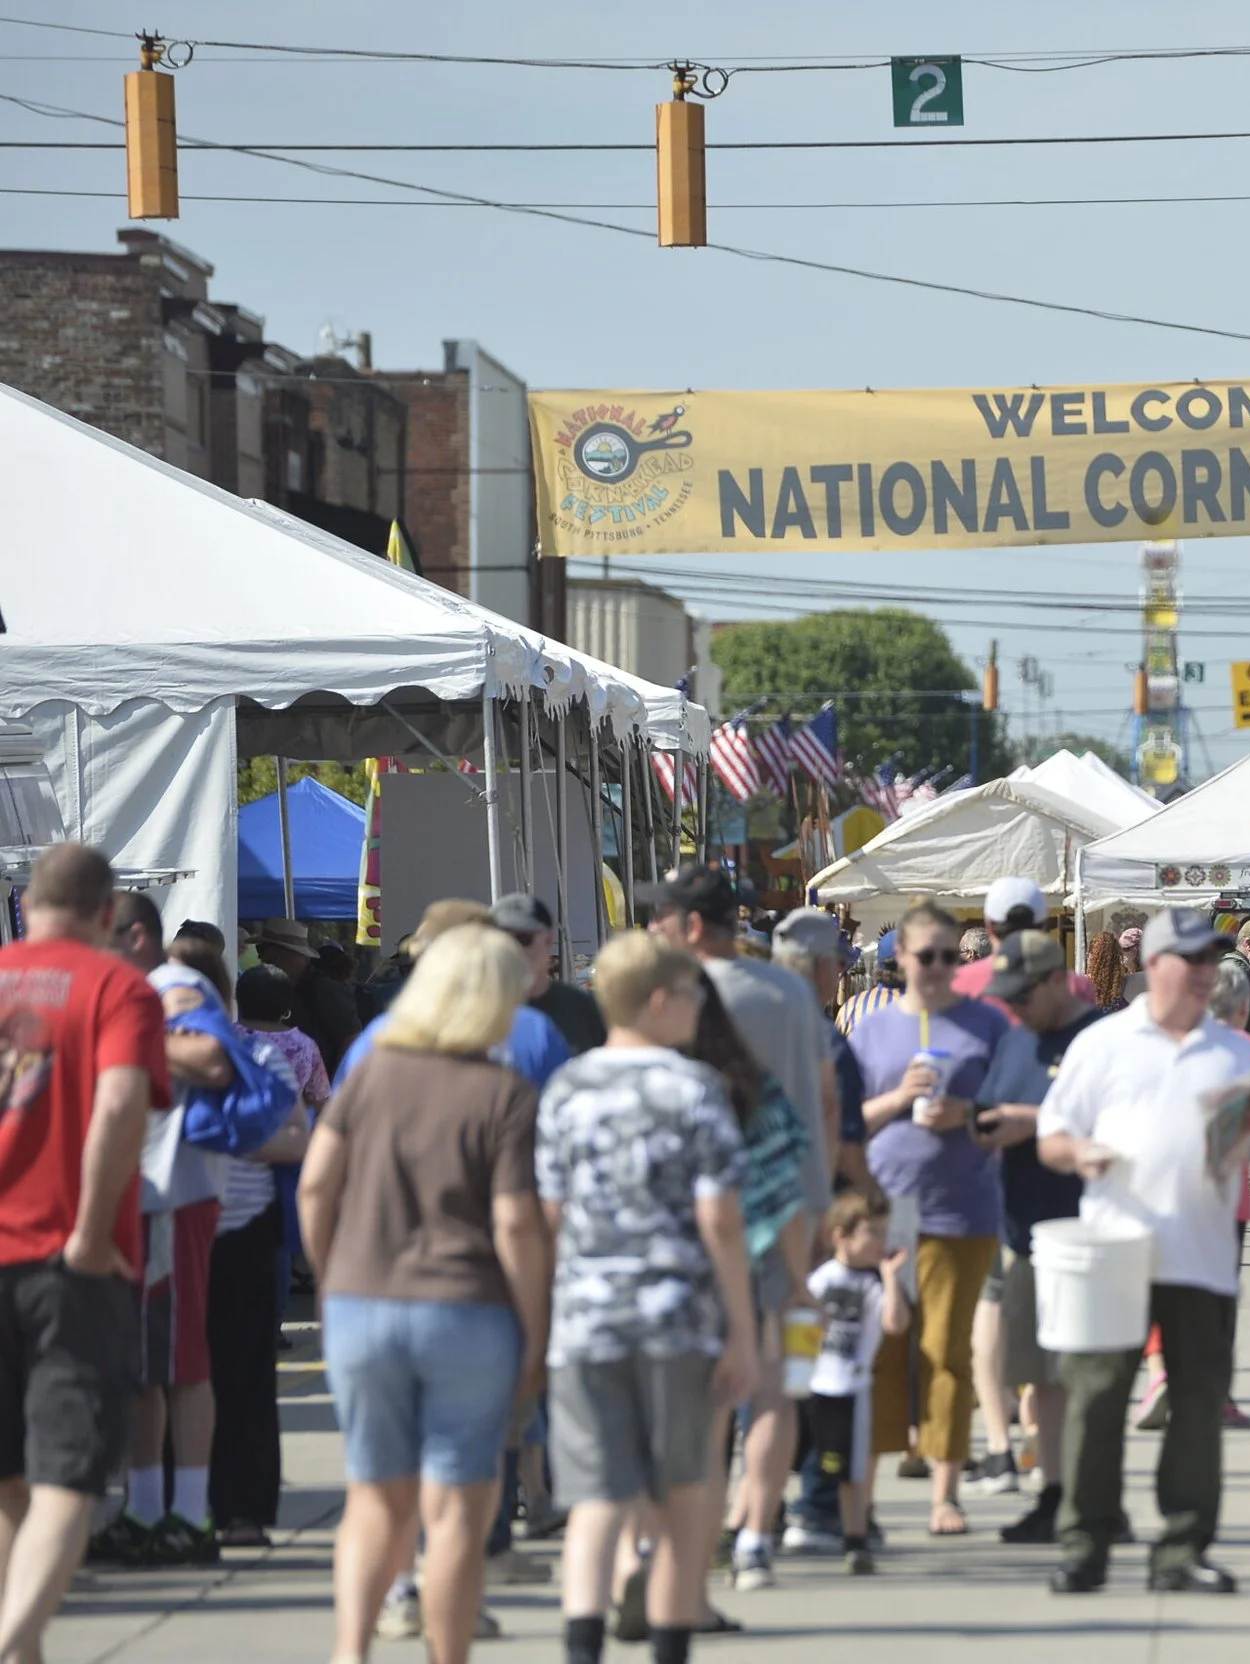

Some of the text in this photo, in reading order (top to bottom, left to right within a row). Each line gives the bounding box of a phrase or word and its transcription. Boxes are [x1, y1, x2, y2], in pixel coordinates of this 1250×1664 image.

[908, 63, 948, 122] 2
[554, 403, 647, 449] NATIONAL
[549, 481, 693, 541] SOUTH PITTSBURG TENNESSEE
[560, 484, 669, 525] FESTIVAL
[718, 455, 1071, 539] NATIONAL
